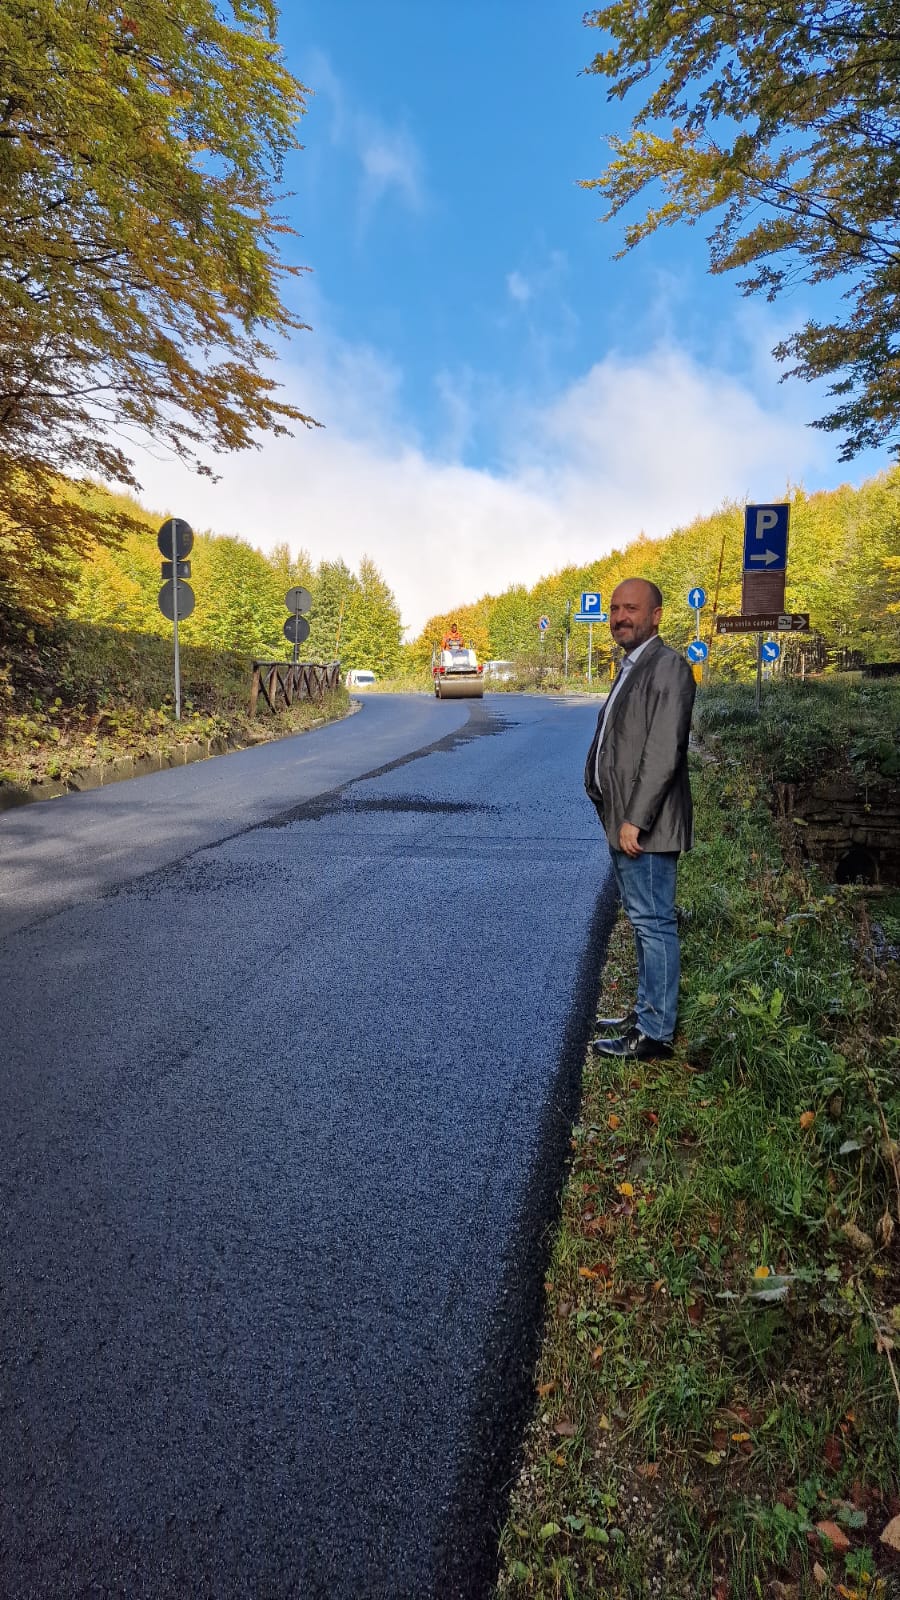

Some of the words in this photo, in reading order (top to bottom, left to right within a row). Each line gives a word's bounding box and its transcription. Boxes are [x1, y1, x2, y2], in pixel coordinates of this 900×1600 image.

[756, 510, 778, 539] P
[585, 595, 598, 611] P
[753, 620, 776, 628] camper
